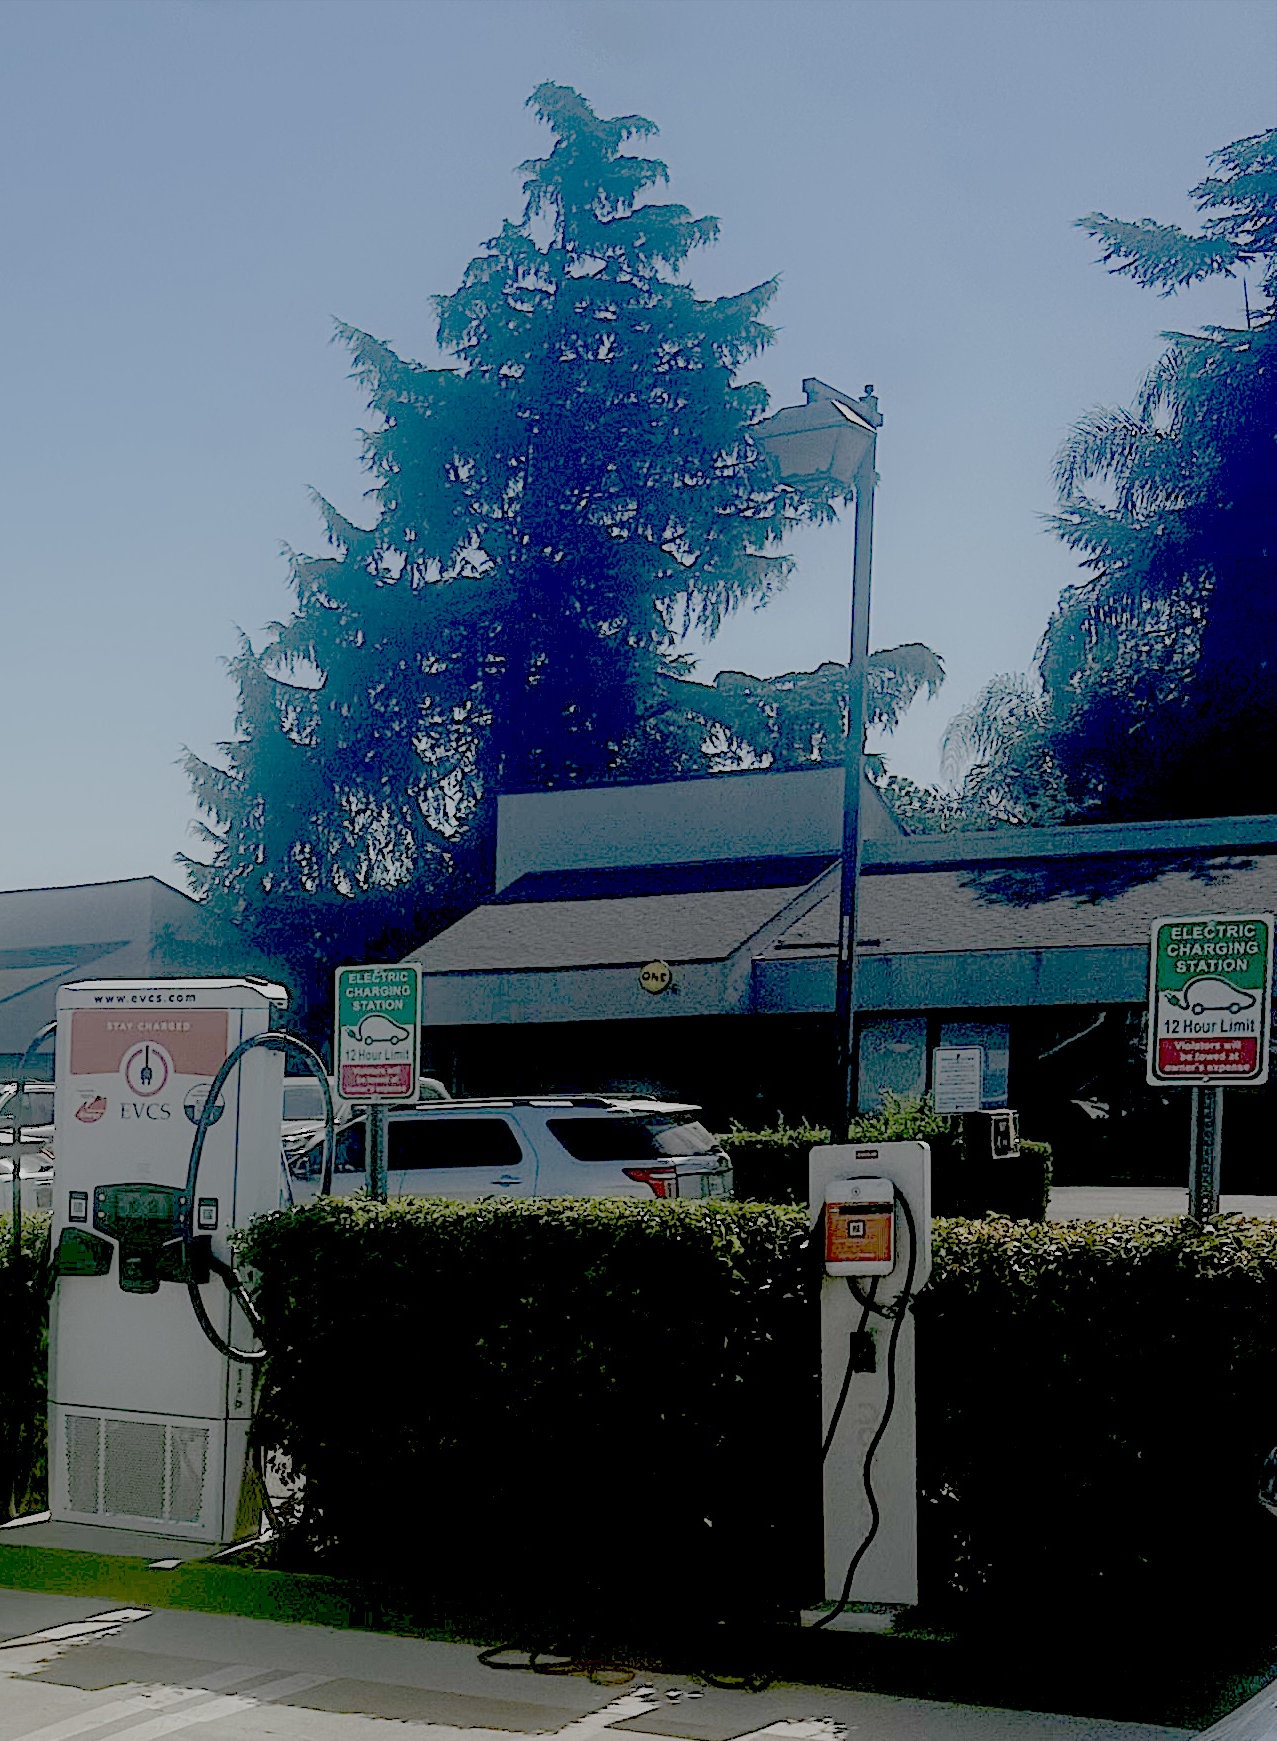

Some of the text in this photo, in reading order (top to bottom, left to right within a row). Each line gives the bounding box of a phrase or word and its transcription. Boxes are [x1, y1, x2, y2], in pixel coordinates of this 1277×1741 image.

[1171, 925, 1256, 940] ELECTRIC
[1167, 942, 1258, 957] CHARGING
[1176, 959, 1248, 973] STATION
[348, 972, 409, 984] ELECTRIC
[345, 985, 411, 997] CHARGING
[94, 994, 196, 1003] www.evcs.com
[352, 1000, 404, 1011] STATION
[106, 1021, 190, 1032] STAY CHARGED
[1164, 1019, 1255, 1034] 12 Hour Limit
[345, 1048, 409, 1061] 12 Hour Limit
[120, 1102, 171, 1120] EVCS
